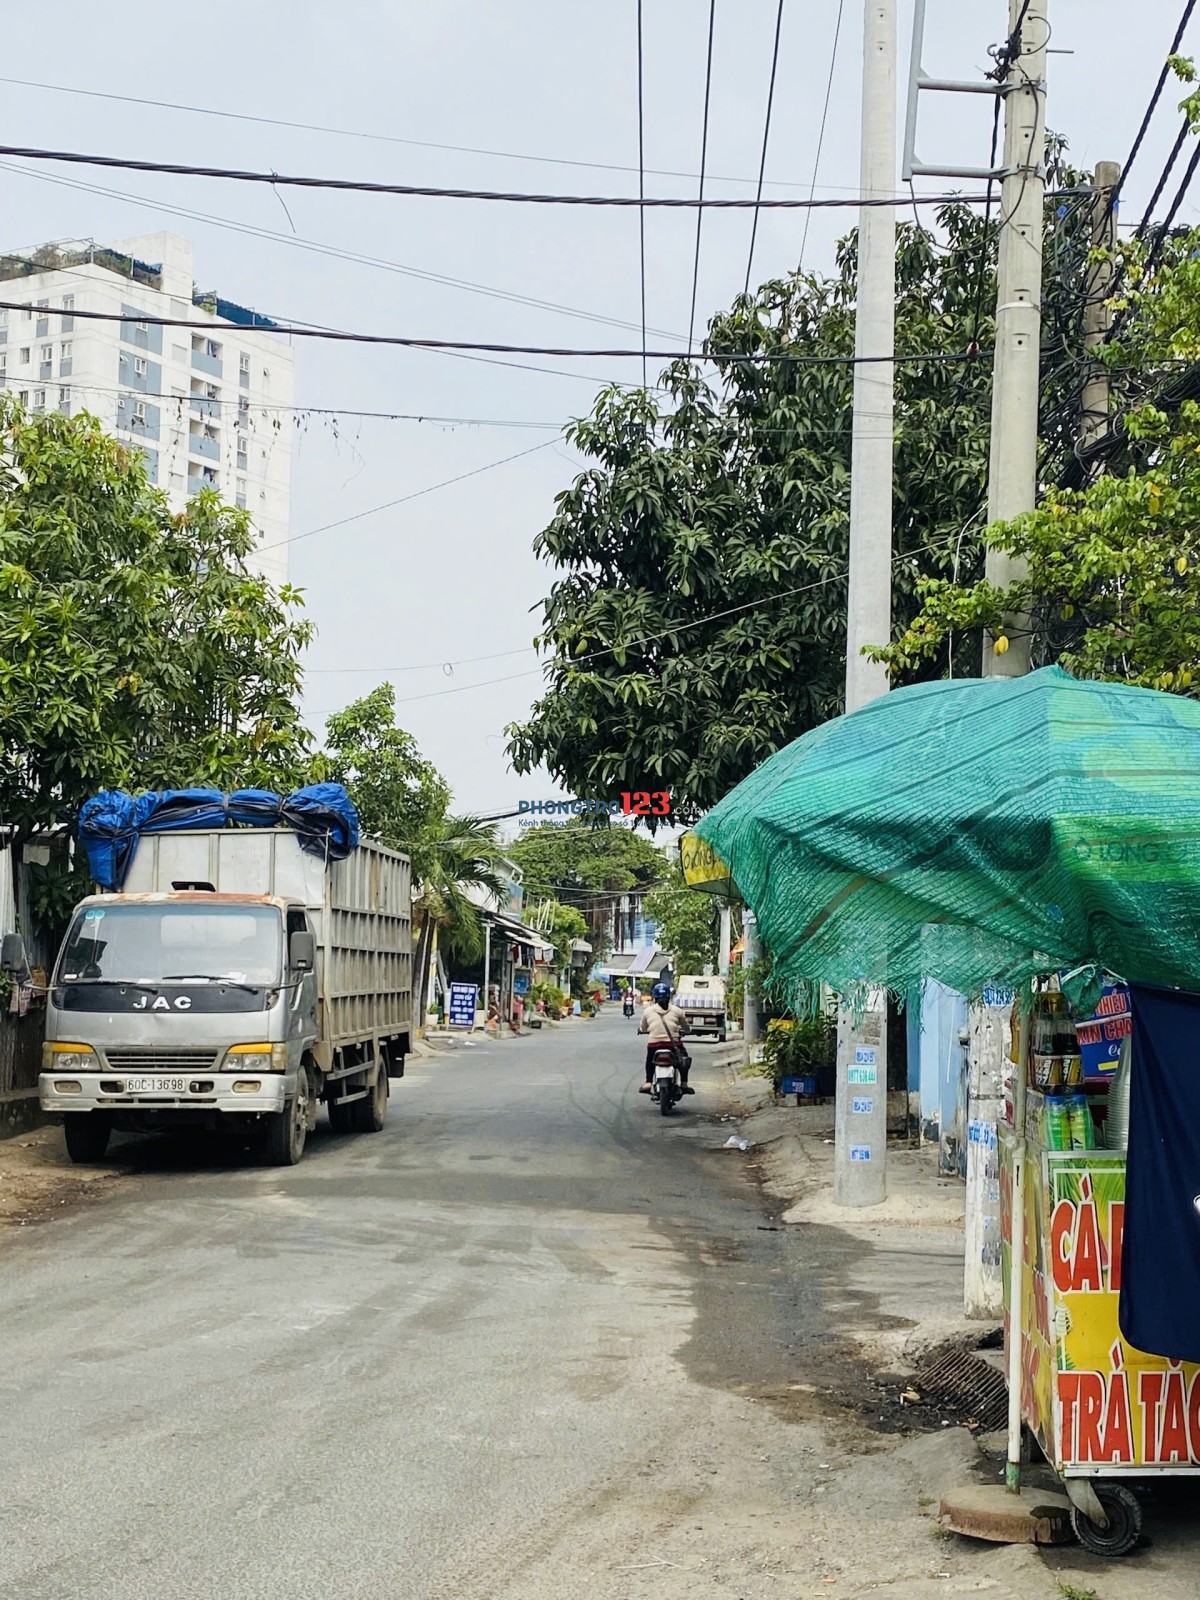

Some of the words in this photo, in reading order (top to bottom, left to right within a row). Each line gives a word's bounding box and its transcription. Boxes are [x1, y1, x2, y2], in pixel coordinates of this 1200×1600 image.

[133, 996, 192, 1010] JAC
[1051, 1173, 1104, 1293] CÀ
[1056, 1338, 1134, 1464] TRÀ
